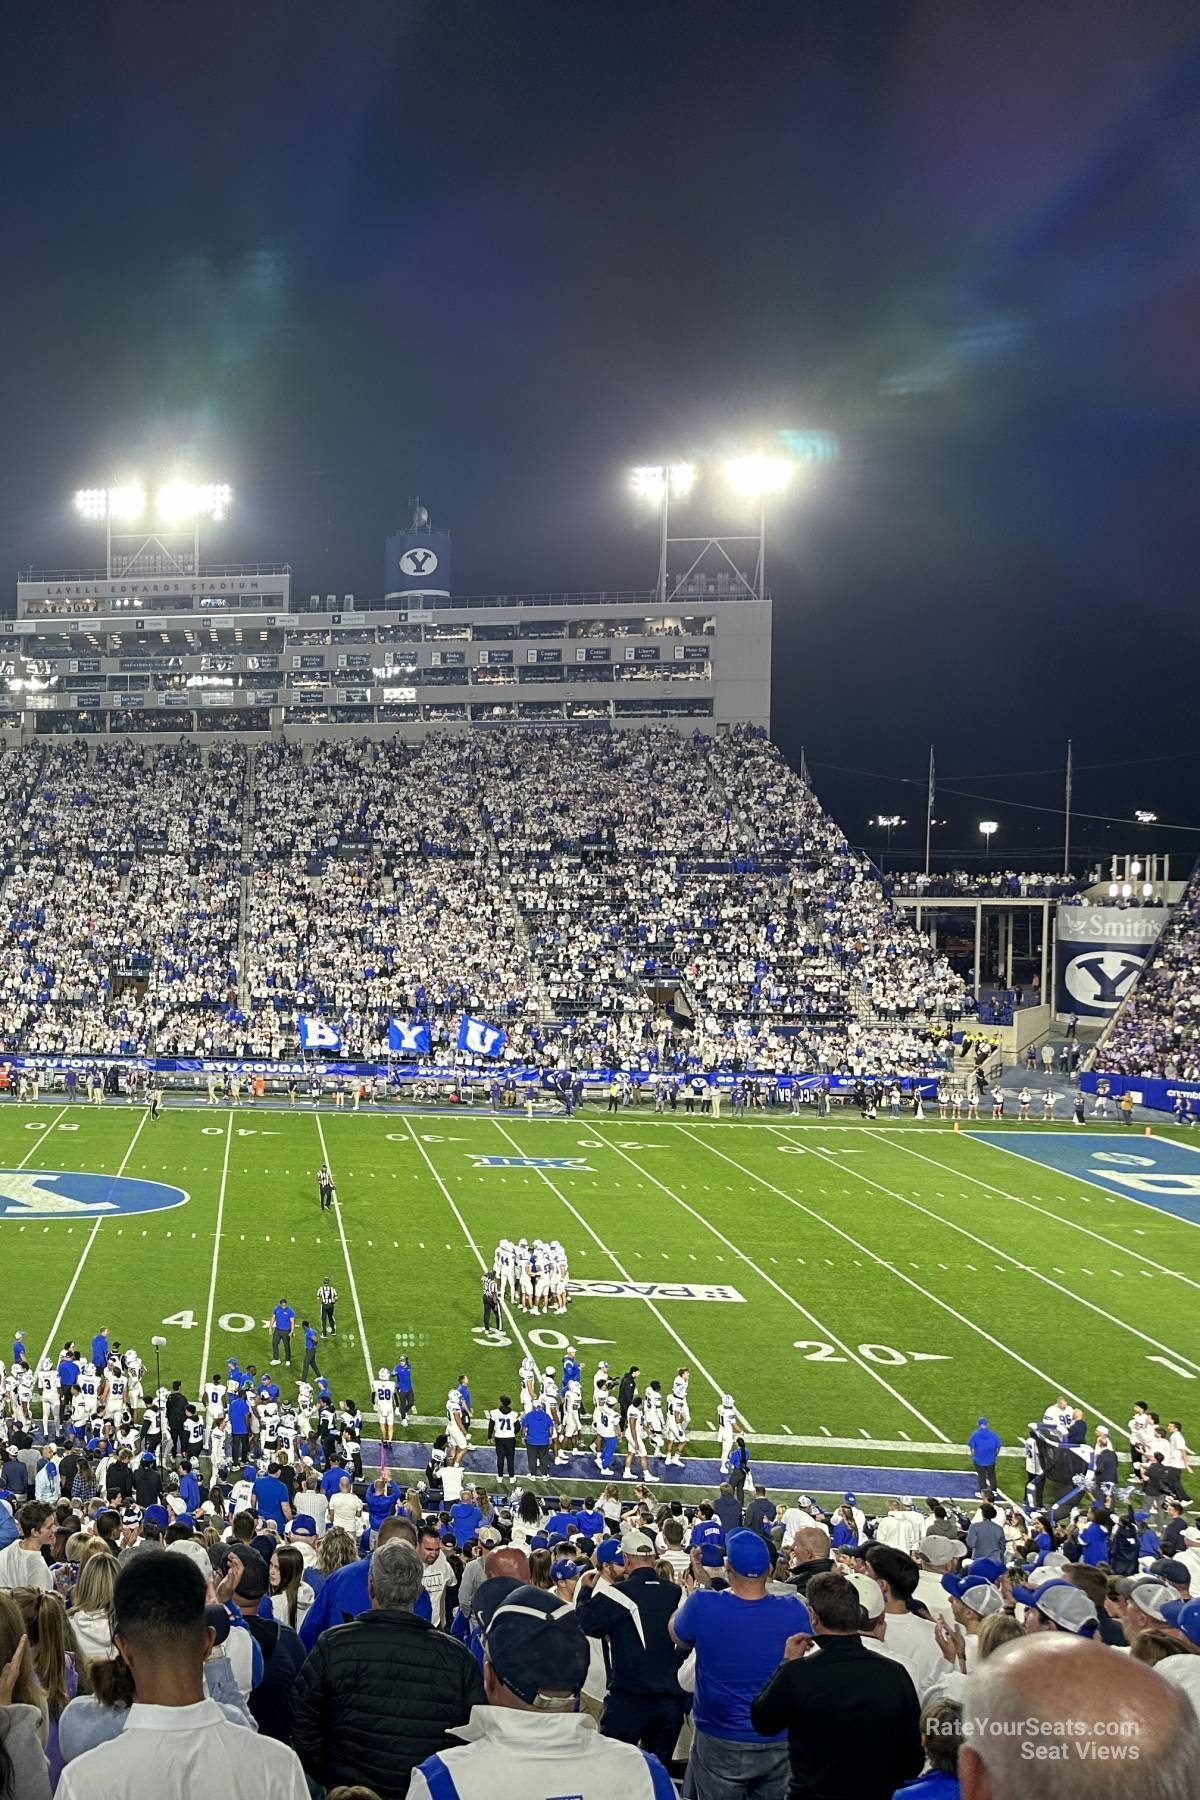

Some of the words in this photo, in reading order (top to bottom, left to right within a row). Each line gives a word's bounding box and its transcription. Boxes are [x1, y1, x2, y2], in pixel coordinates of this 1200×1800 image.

[406, 550, 431, 574] Y
[46, 586, 99, 595] LAVELL
[111, 583, 179, 593] EDWARDS
[191, 581, 259, 591] STADIUM
[1089, 914, 1162, 937] Smith's
[1076, 957, 1146, 1000] Y
[305, 1018, 340, 1047] B
[393, 1021, 424, 1050] Y
[466, 1021, 499, 1054] U
[24, 1058, 58, 1067] BYU
[203, 1062, 238, 1072] BYU
[24, 1122, 80, 1131] 50
[200, 1127, 266, 1136] 40
[385, 1133, 446, 1144] 30
[577, 1139, 644, 1150] 20
[777, 1145, 838, 1156] 10
[162, 1310, 256, 1332] 40
[471, 1326, 570, 1349] 30
[792, 1340, 908, 1366] 20
[44, 1378, 51, 1389] 3
[112, 1383, 124, 1395] 93
[211, 1391, 218, 1403] 0
[378, 1389, 390, 1400] 28
[499, 1418, 512, 1430] 71
[1058, 1414, 1072, 1426] 96
